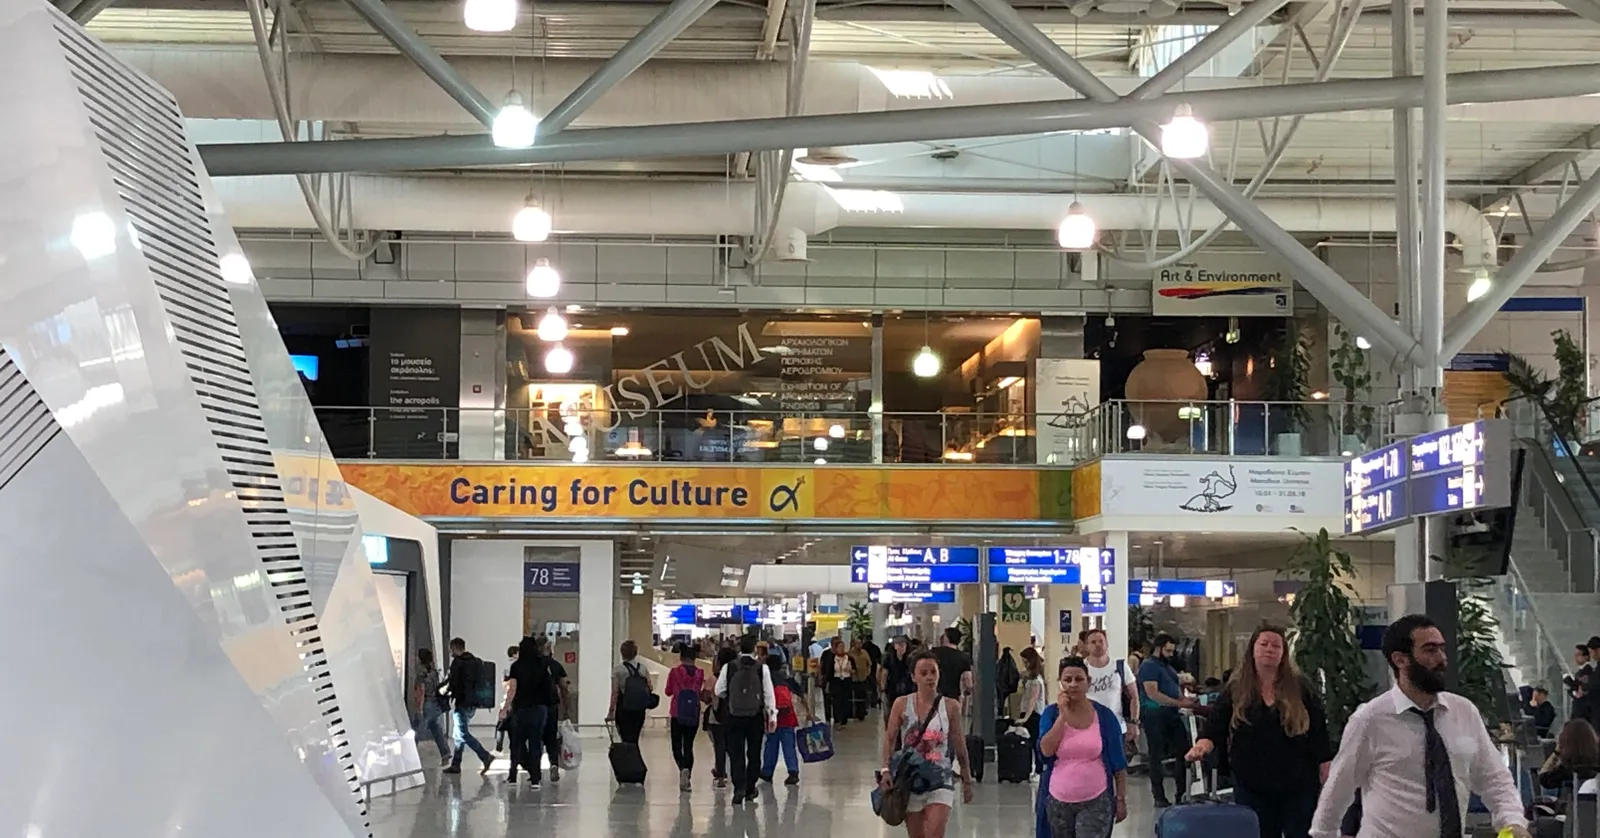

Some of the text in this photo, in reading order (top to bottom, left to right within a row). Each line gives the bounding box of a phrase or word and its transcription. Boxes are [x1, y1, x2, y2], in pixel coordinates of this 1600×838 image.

[1160, 269, 1282, 282] Art & Environment
[390, 396, 440, 406] the acropolis
[450, 477, 748, 512] Caring for Culture
[940, 548, 949, 562] B
[1053, 549, 1080, 564] 1-78
[530, 568, 549, 585] 78
[1004, 613, 1028, 622] AED
